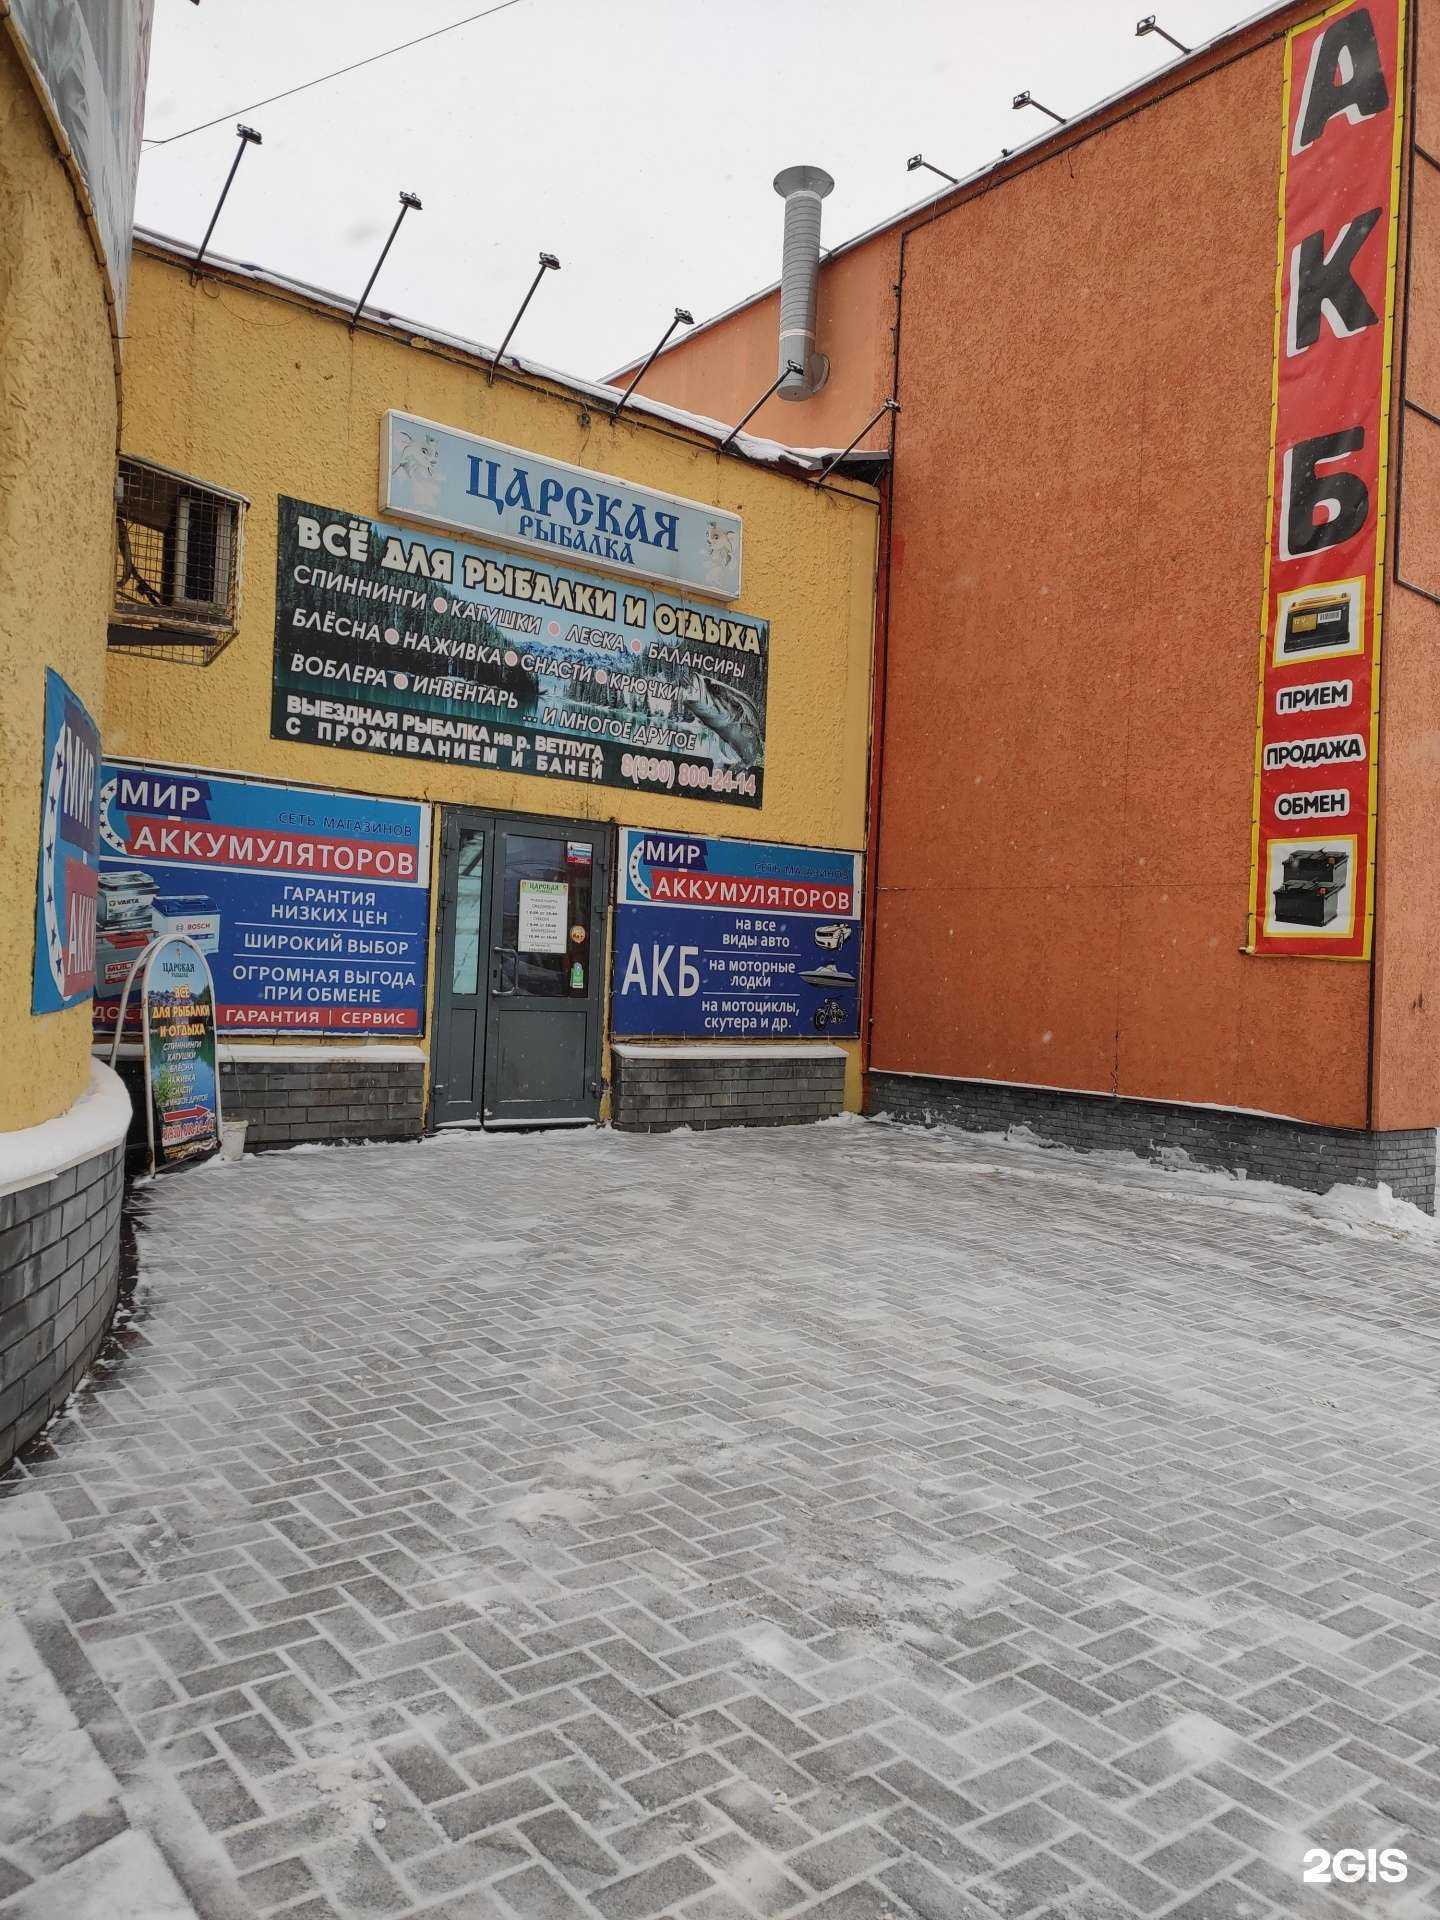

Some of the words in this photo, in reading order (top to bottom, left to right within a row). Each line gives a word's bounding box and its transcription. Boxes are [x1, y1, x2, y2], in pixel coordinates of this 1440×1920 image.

[465, 455, 679, 551] ЦАРСКАЯ
[519, 515, 635, 564] РЫБАЛКА
[298, 516, 370, 562] ВСЁ
[381, 537, 453, 583] ДЛЯ
[464, 555, 616, 622] РЫБАЛКИ
[623, 594, 648, 629] И
[654, 603, 762, 655] ОТДЫХА
[293, 565, 427, 610] СПИННИНГИ
[451, 599, 542, 635] КАТУШКИ
[565, 625, 627, 653] ЛЕСКА
[648, 643, 746, 679] БАЛАНСИРЫ
[293, 608, 381, 643] БЛЁСНА
[403, 632, 501, 666] НАЖИВКА
[521, 655, 592, 683] СНАСТИ
[609, 674, 680, 702] КРЮЧКИ
[290, 654, 387, 688] ВОБЛЕРА
[413, 675, 519, 710] ИНВЕНТАРЬ
[1280, 684, 1348, 710] ПРИЕМ
[287, 694, 399, 730] ВЫЕЗДНАЯ
[403, 714, 490, 743] РЫБАЛКА
[494, 732, 513, 747] на
[517, 737, 531, 753] р.
[535, 736, 604, 761] ВЕТЛУГА
[543, 708, 556, 726] И
[560, 713, 631, 738] МНОГОЕ
[634, 726, 697, 751] ДРУГОЕ
[286, 717, 301, 735] С
[317, 722, 498, 765] ПРОЖИВАНИЕМ
[511, 751, 523, 767] И
[536, 757, 603, 779] БАНЕЙ
[1266, 739, 1361, 765] ПРОДАЖА
[64, 726, 94, 830] МИР
[621, 753, 675, 789] 8(930)
[678, 763, 756, 796] 800-24-14
[120, 779, 200, 811] МИР
[1278, 793, 1345, 816] ОБМЕН
[279, 811, 316, 826] СЕТЬ
[323, 816, 413, 837] МАГАЗИНОВ
[134, 826, 414, 875] АККУМУЛЯТОРОВ
[647, 840, 700, 864] МИР
[117, 898, 140, 906] VARTA
[283, 886, 376, 906] ГАРАНТИЯ
[656, 877, 849, 910] АККУМУЛЯТОРОВ
[187, 923, 211, 931] BOSCH
[271, 904, 348, 922] НИЗКИХ
[352, 911, 387, 927] ЦЕН
[735, 918, 751, 929] на
[755, 919, 776, 932] все
[244, 933, 343, 952] ШИРОКИЙ
[348, 939, 409, 955] ВЫБОР
[722, 933, 757, 948] виды
[760, 935, 790, 947] авто
[162, 962, 195, 974] ЦАРСКАЯ
[233, 965, 339, 983] ОГРОМНАЯ
[344, 970, 416, 989] ВЫГОДА
[620, 943, 700, 997] АКБ
[709, 959, 726, 971] на
[728, 961, 796, 976] моторные
[730, 975, 771, 989] лодки
[264, 986, 302, 1000] ПРИ
[307, 987, 381, 1003] ОБМЕНЕ
[152, 1006, 171, 1019] ДЛЯ
[172, 1003, 211, 1018] РЫБАЛКИ
[225, 1009, 319, 1024] ГАРАНТИЯ
[341, 1011, 405, 1025] СЕРВИС
[701, 1000, 718, 1012] на
[721, 1001, 800, 1017] мотоциклы,
[168, 1023, 205, 1036] ОТДЫХА
[704, 1017, 757, 1032] скутера
[760, 1019, 769, 1029] и
[771, 1019, 792, 1033] др.
